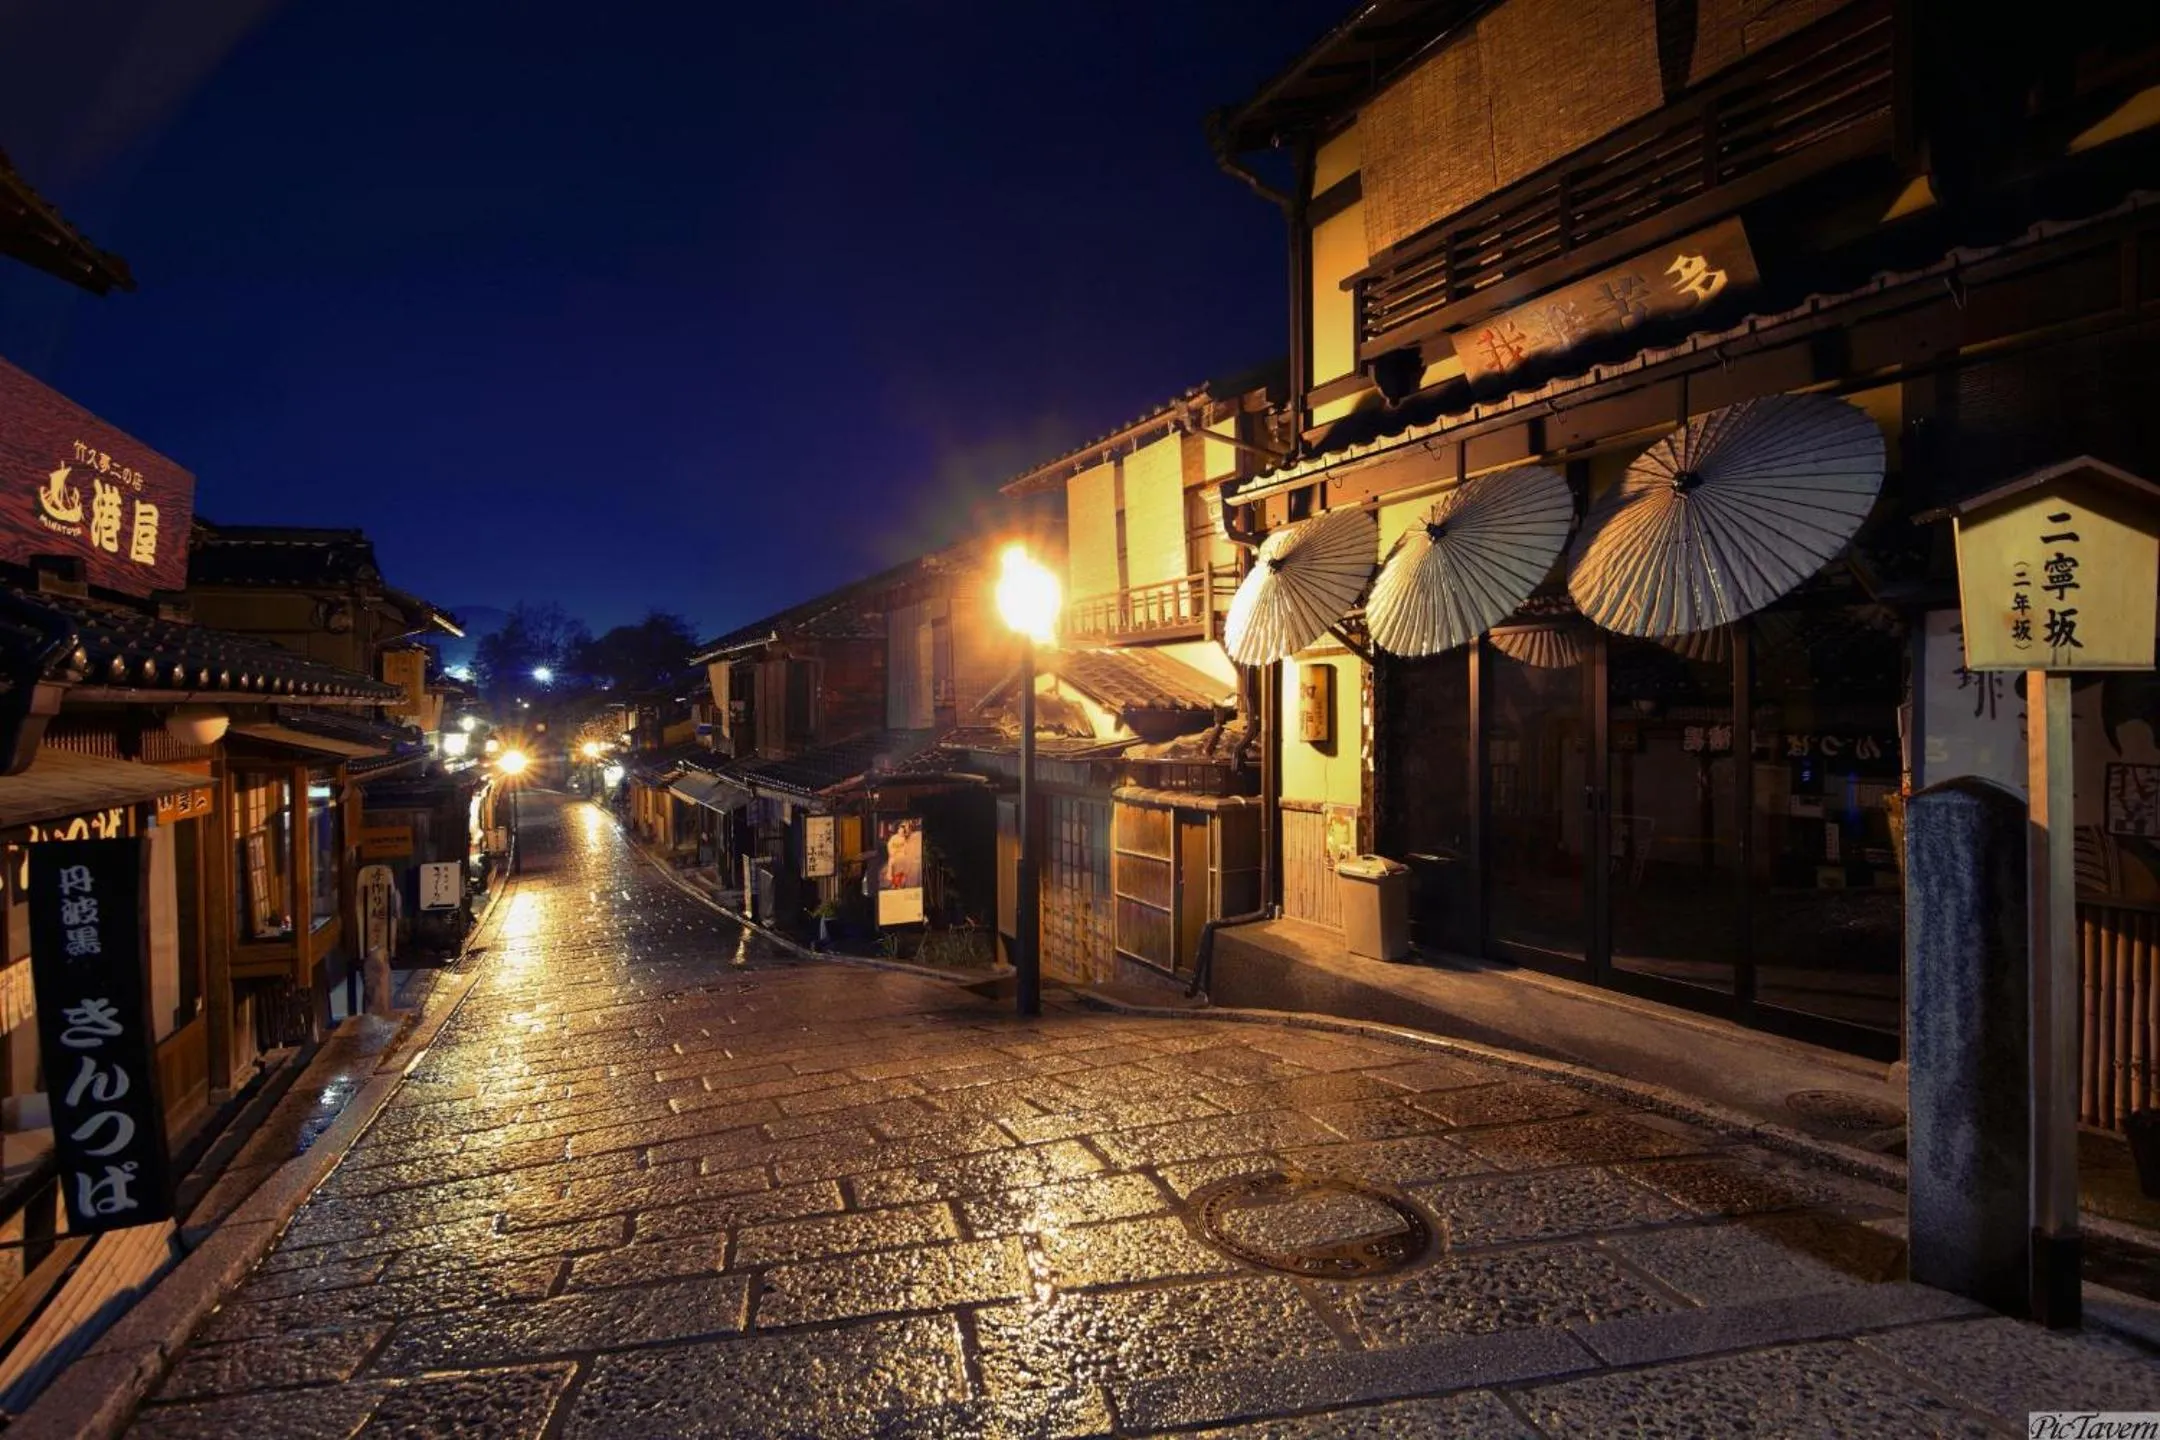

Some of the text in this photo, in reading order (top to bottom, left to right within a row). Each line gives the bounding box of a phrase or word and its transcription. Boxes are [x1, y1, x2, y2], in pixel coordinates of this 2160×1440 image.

[73, 439, 145, 492] 竹久夢二の店
[91, 478, 160, 566] 港屋
[2040, 512, 2084, 648] 二寧坂
